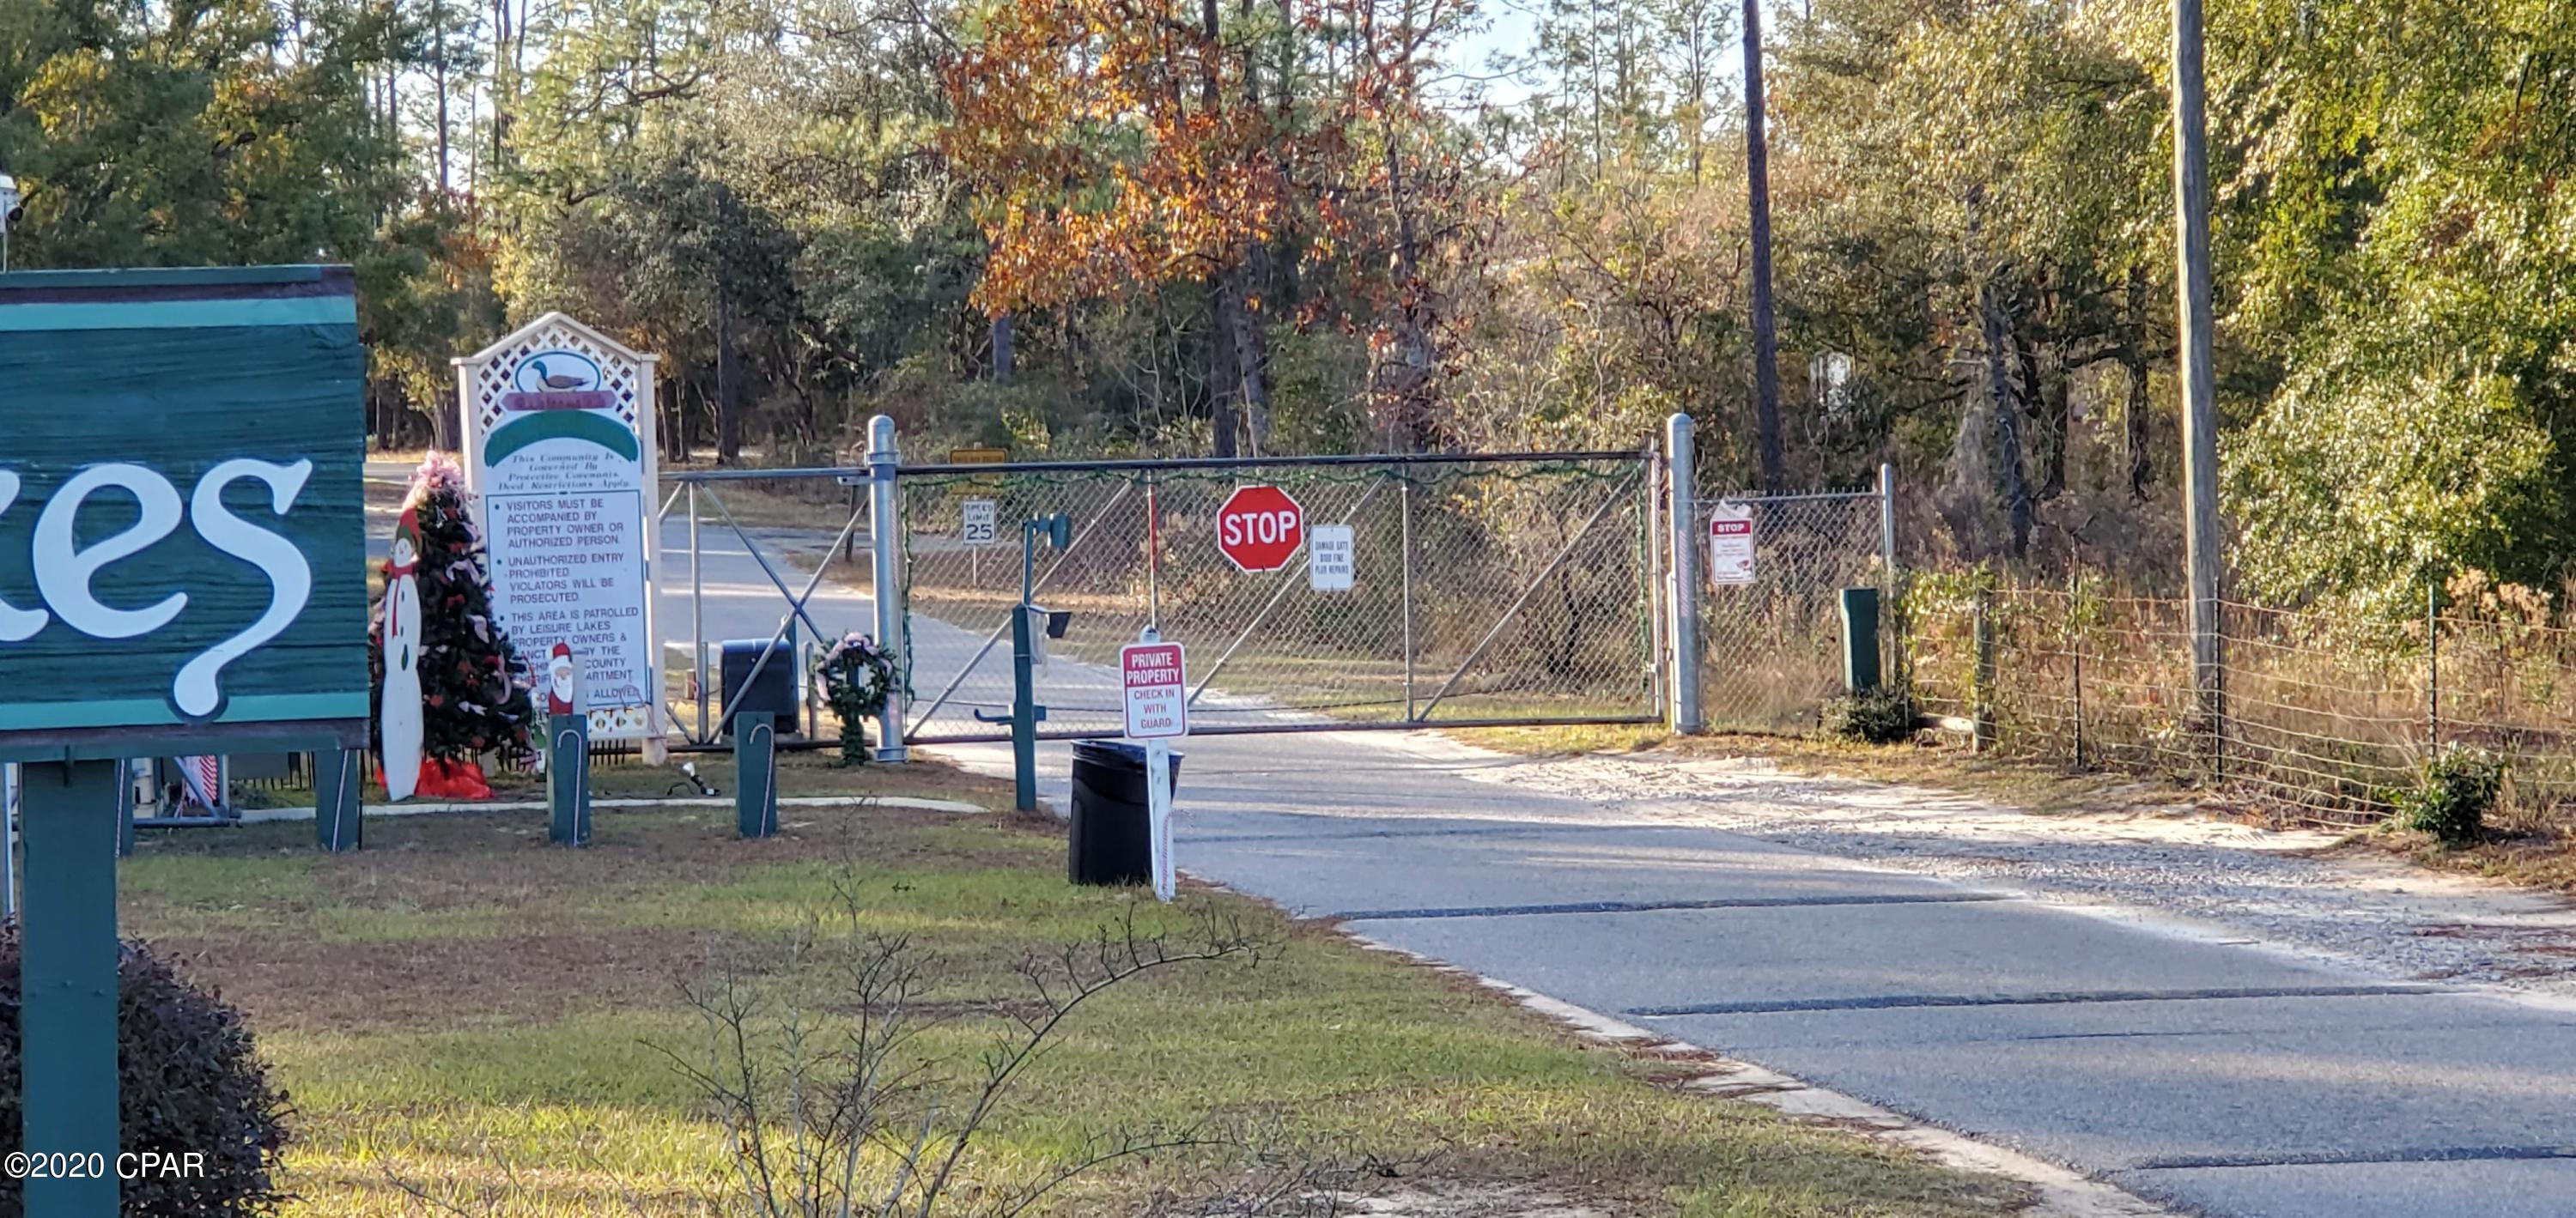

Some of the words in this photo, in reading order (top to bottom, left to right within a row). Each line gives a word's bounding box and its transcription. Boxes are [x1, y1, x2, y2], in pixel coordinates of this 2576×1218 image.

[507, 500, 553, 512] VISITORS
[558, 499, 585, 509] MUST
[591, 498, 605, 508] BE
[507, 512, 580, 524] ACCOMPANIED
[584, 511, 598, 521] BY
[507, 525, 561, 536] PROPERTY
[567, 524, 604, 534] OWNER
[609, 522, 624, 532] OR
[966, 524, 993, 540] 25
[1224, 511, 1297, 547] STOP
[1717, 523, 1745, 532] STOP
[508, 536, 573, 548] AUTHORIZED
[508, 554, 587, 567] UNAUTHORIZED
[592, 552, 624, 563] ENTRY
[510, 579, 568, 591] VIOLATORS
[573, 578, 596, 589] WILL
[600, 577, 614, 588] BE
[512, 612, 534, 622] THIS
[538, 611, 566, 621] AREA
[571, 610, 580, 619] IS
[584, 607, 639, 619] PATROLLED
[512, 625, 525, 635] BY
[530, 623, 572, 633] LEISURE
[577, 621, 611, 632] LAKES
[512, 635, 567, 647] PROPERTY
[572, 633, 616, 644] OWNERS
[620, 633, 627, 642] &
[601, 645, 621, 655] THE
[1131, 652, 1174, 668] PRIVATE
[586, 670, 633, 681] ARTMENT
[1126, 668, 1179, 685] PROPERTY
[594, 687, 640, 698] ALLOWED
[1133, 689, 1163, 700] CHECK
[1165, 688, 1175, 698] IN
[1144, 704, 1167, 714] WITH
[1140, 718, 1172, 729] GUARD
